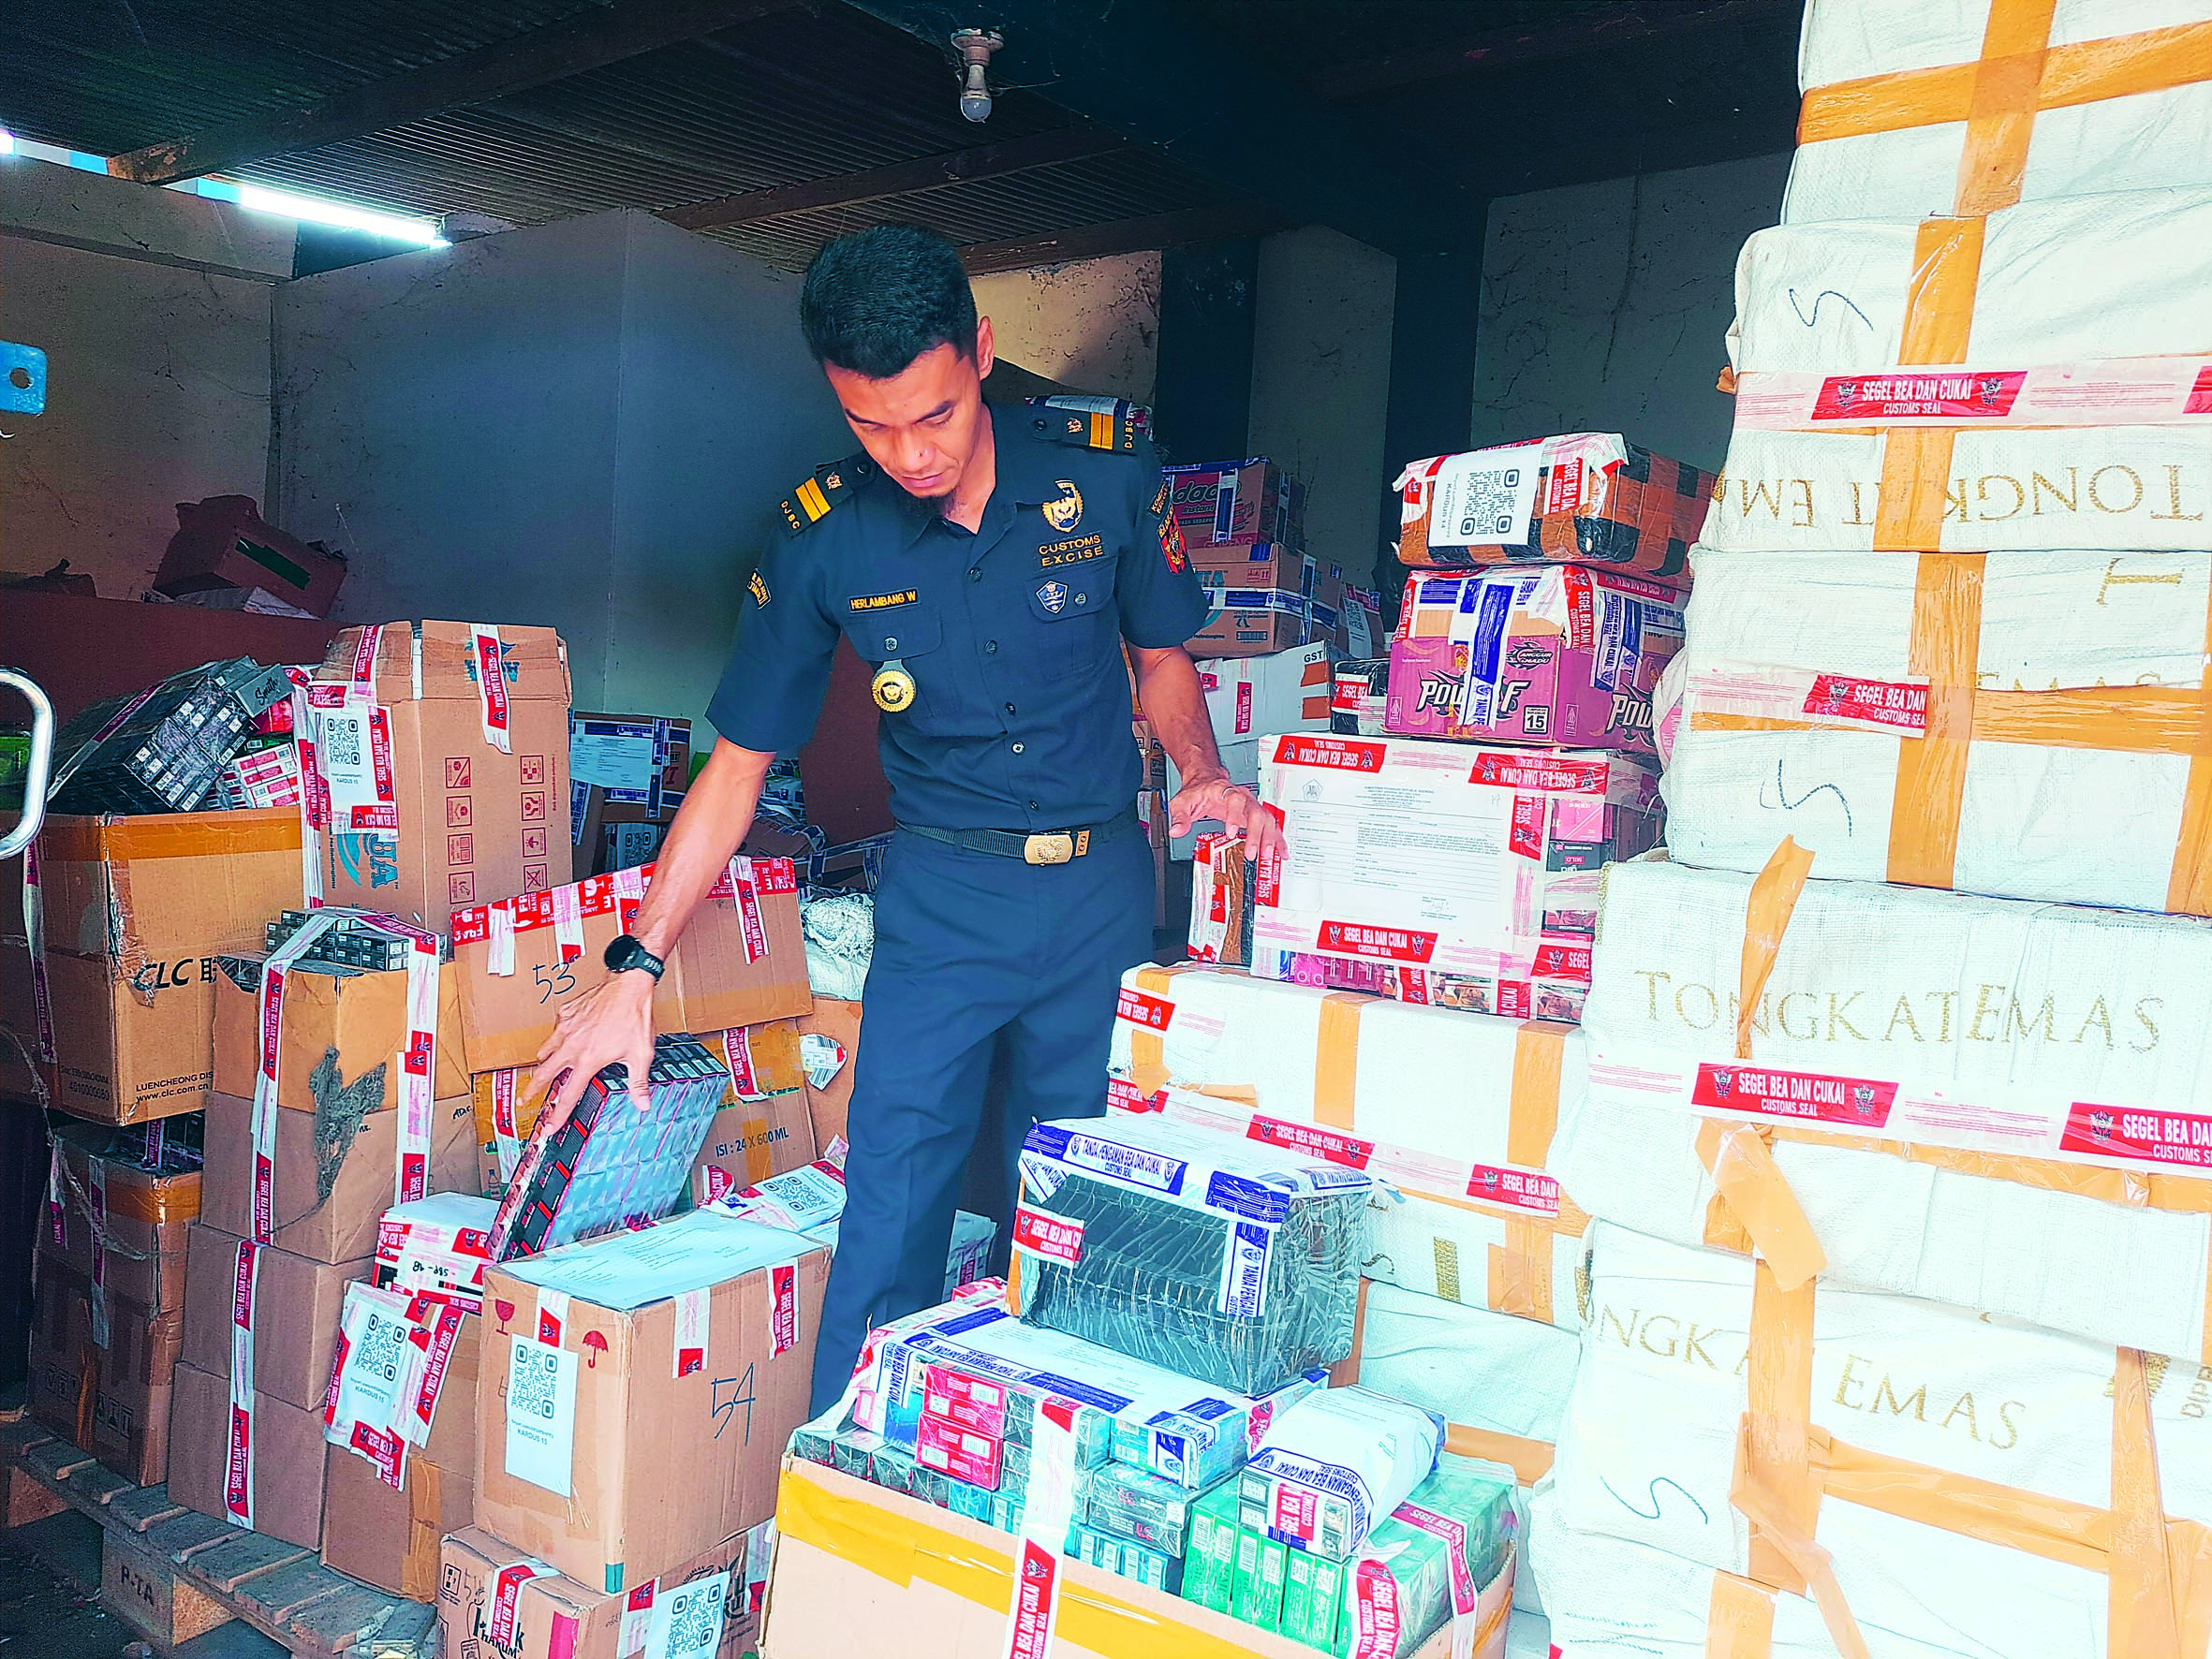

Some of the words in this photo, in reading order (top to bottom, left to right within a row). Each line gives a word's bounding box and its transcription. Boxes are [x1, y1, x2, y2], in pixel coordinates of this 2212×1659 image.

[1862, 380, 1893, 402] SEGEL
[1895, 380, 1913, 401] BEA
[1914, 379, 1938, 400] DAN
[1939, 377, 1971, 400] CUKAI
[1883, 403, 1920, 416] CUSTOMS
[1922, 402, 1942, 415] SEAL
[1124, 420, 1134, 449] DJBC
[1552, 478, 1563, 505] CUSTOMS
[1562, 481, 1578, 496] BEA
[1842, 464, 2203, 525] TONGKT
[781, 500, 801, 530] DJBC
[1039, 535, 1101, 555] CUSTOMS
[1041, 546, 1104, 567] EXCISE
[850, 592, 905, 610] HERLAMBANG
[906, 590, 917, 602] W
[1578, 591, 1590, 613] SEGEL
[1570, 609, 1580, 634] CUSTOMS
[1579, 613, 1591, 625] BEA
[1572, 635, 1581, 650] SEAL
[1580, 626, 1591, 643] DAN
[1304, 650, 1324, 663] GST
[254, 674, 280, 706] Smith
[1341, 684, 1357, 698] SEGEL
[1853, 684, 1884, 706] SEGEL
[1886, 687, 1905, 708] BEA
[1907, 689, 1926, 710] DAN
[1526, 714, 1545, 728] 15
[1605, 693, 1653, 734] POW
[1873, 707, 1910, 725] CUSTOMS
[1314, 740, 1325, 749] SEAL
[1325, 741, 1346, 751] CUSTOMS
[1298, 747, 1317, 764] CUKAI
[1317, 749, 1330, 765] DAN
[1330, 750, 1341, 766] BEA
[1341, 751, 1360, 768] SEGEL
[1499, 768, 1522, 784] CUKAI
[1556, 771, 1577, 788] SEGEL
[1515, 806, 1531, 825] SEGEL
[1260, 867, 1272, 879] BEA
[1258, 880, 1271, 899] SEGEL
[745, 901, 757, 918] SEGEL
[748, 917, 759, 928] BEA
[750, 927, 761, 940] DAN
[1344, 926, 1362, 943] SEGEL
[1362, 928, 1375, 945] BEA
[1375, 930, 1388, 947] DAN
[1388, 932, 1408, 948] CUKAI
[1358, 944, 1379, 955] CUSTOMS
[1379, 947, 1393, 957] SEAL
[1568, 951, 1590, 969] SEGEL
[134, 958, 194, 991] CLC
[532, 961, 576, 1005] 53
[1501, 987, 1518, 1009] CUKAI
[1132, 1004, 1149, 1021] SEGEL
[136, 1075, 191, 1093] LUENCHEONG
[136, 1082, 209, 1103] www.clc.com.cn
[1738, 1072, 1768, 1095] SEGEL
[1770, 1075, 1789, 1097] BEA
[1791, 1077, 1811, 1100] DAN
[1813, 1079, 1846, 1104] CUKAI
[1761, 1097, 1796, 1114] CUSTOMS
[1797, 1102, 1819, 1117] SEAL
[1276, 1123, 1295, 1140] SEGEL
[1295, 1128, 1310, 1143] BEA
[1309, 1131, 1323, 1147] DAN
[1322, 1136, 1344, 1152] CUKAI
[2122, 1113, 2161, 1141] SEGEL
[2163, 1118, 2190, 1144] BEA
[715, 1143, 729, 1158] ISI
[734, 1138, 747, 1152] 24
[747, 1136, 756, 1150] X
[756, 1131, 774, 1147] 600
[774, 1126, 789, 1141] ML
[1289, 1142, 1312, 1156] CUSTOMS
[1313, 1147, 1326, 1159] SEAL
[1083, 1139, 1099, 1158] TANDA
[1099, 1144, 1126, 1165] PENGAMAN
[1125, 1150, 1136, 1167] BEA
[1134, 1152, 1146, 1172] DAN
[1145, 1156, 1163, 1175] CUKAI
[2153, 1144, 2201, 1165] CUSTOMS
[1104, 1162, 1123, 1177] CUSTOMS
[1123, 1167, 1132, 1179] SEAL
[1501, 1173, 1525, 1193] SEGEL
[1526, 1178, 1540, 1196] BEA
[1541, 1181, 1556, 1198] DAN
[1518, 1194, 1544, 1208] CUSTOMS
[1031, 1218, 1050, 1240] SEGEL
[1049, 1223, 1061, 1242] BEA
[1059, 1227, 1072, 1246] DAN
[1040, 1240, 1062, 1255] CUSTOMS
[1063, 1246, 1074, 1259] SEAL
[1242, 1264, 1260, 1287] TANDA
[781, 1291, 792, 1313] SEGEL
[782, 1313, 793, 1327] BEA
[437, 1329, 452, 1350] SEGEL
[782, 1327, 794, 1342] DAN
[355, 1386, 377, 1401] KARDUS
[1832, 1354, 2027, 1450] EMAS
[711, 1362, 757, 1446] 54
[517, 1428, 539, 1444] KARDUS
[1275, 1461, 1301, 1476] CUKAI
[1297, 1467, 1314, 1481] DAN
[1319, 1464, 1333, 1474] SEAL
[1332, 1467, 1358, 1485] CUSTOMS
[1313, 1471, 1329, 1488] BEA
[1325, 1477, 1364, 1503] PENGAMAN
[1280, 1496, 1300, 1514] BEA
[1409, 1509, 1437, 1524] SEGEL
[1436, 1519, 1453, 1533] BEA
[504, 1583, 516, 1607] SEGEL
[1021, 1580, 1040, 1612] CUKAI
[1373, 1578, 1394, 1608] SEGEL
[502, 1608, 513, 1621] BEA
[1019, 1610, 1037, 1630] DAN
[1036, 1611, 1048, 1630] SEAL
[1361, 1600, 1375, 1635] CUSTOMS
[1375, 1609, 1395, 1628] BEA
[500, 1622, 512, 1638] DAN
[1016, 1631, 1035, 1652] BEA
[1359, 1636, 1374, 1653] SEAL
[1373, 1629, 1396, 1652] DAN
